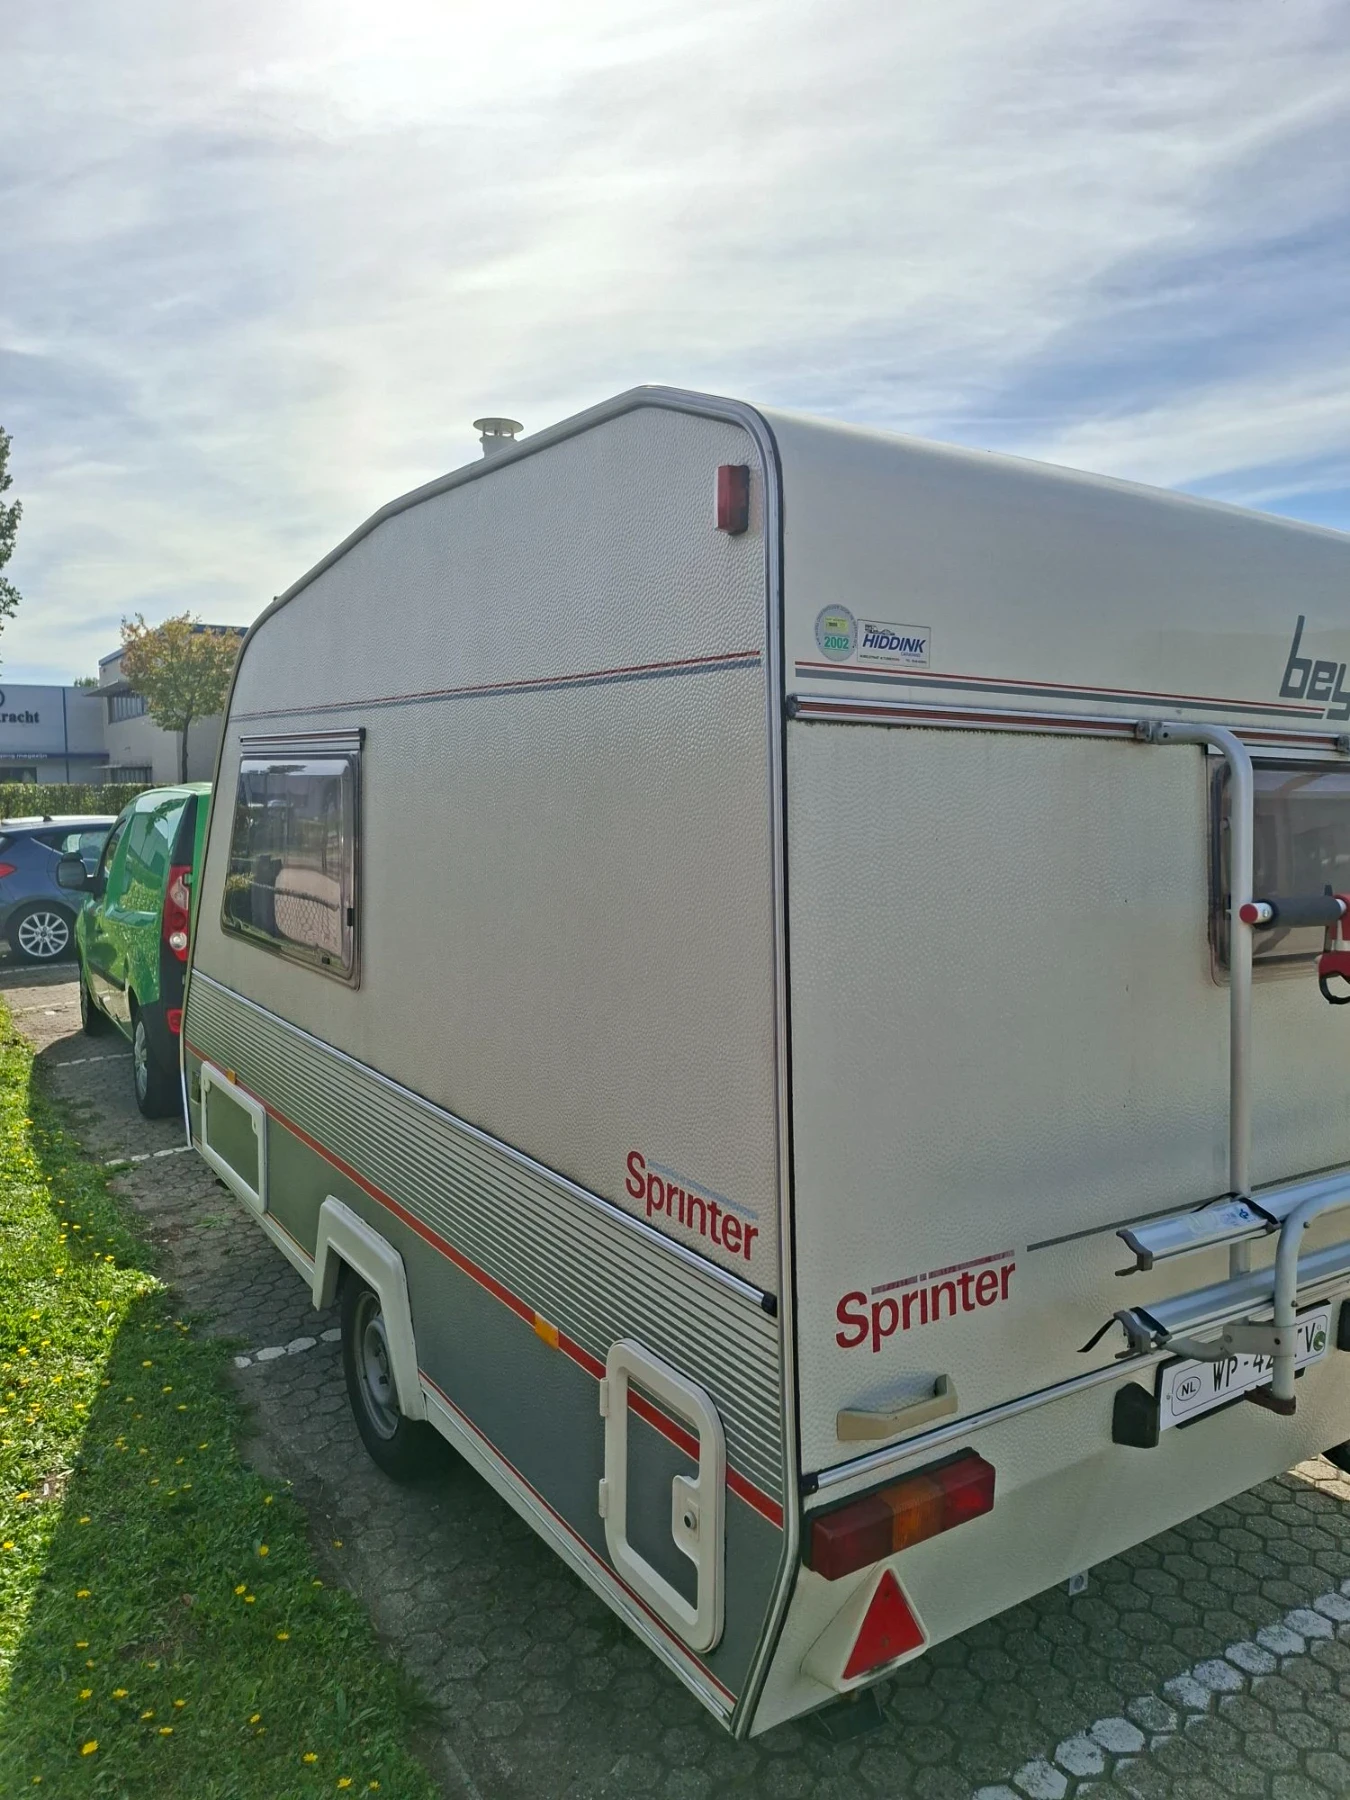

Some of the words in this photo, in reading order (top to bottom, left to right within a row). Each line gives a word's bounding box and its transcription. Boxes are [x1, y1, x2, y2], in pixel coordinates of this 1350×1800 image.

[824, 636, 846, 649] 2002
[862, 633, 926, 653] HIDDINK
[0, 711, 39, 723] racht
[626, 1151, 758, 1261] Sprinter
[836, 1263, 1015, 1353] Sprinter
[1181, 1385, 1196, 1397] NL
